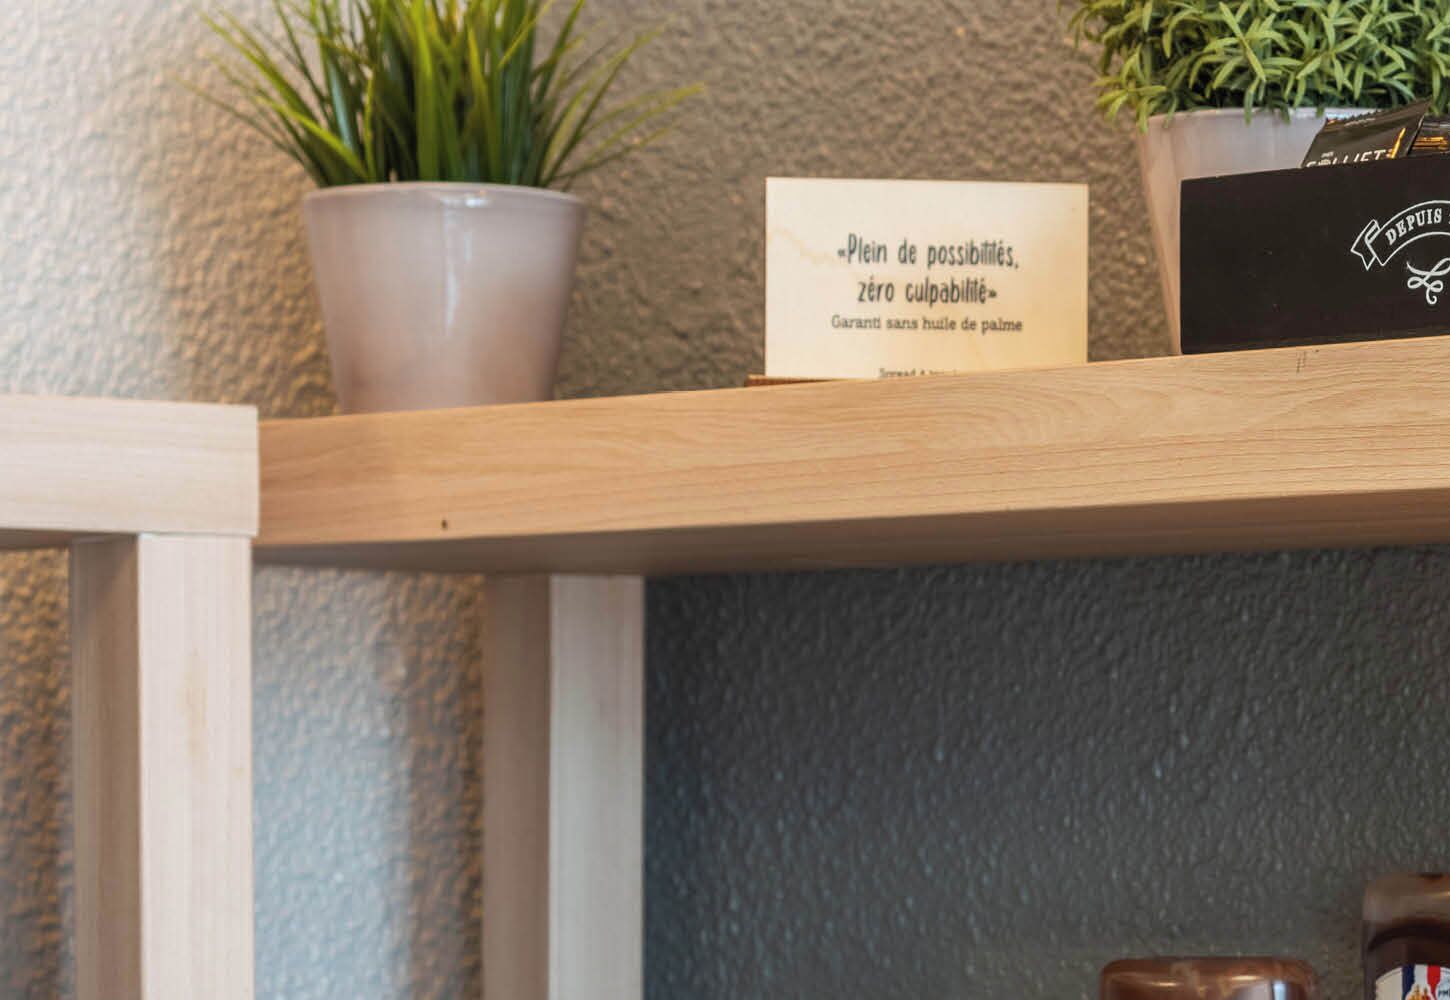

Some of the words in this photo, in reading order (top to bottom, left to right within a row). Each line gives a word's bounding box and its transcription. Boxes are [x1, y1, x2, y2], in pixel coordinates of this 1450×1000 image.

[1384, 207, 1443, 246] DEPUIS
[837, 232, 888, 264] «Plein
[897, 236, 918, 265] de
[927, 238, 1020, 270] possibilités,
[857, 274, 896, 303] zéro
[831, 314, 882, 330] Garanti
[886, 318, 919, 330] sans
[922, 316, 957, 331] huile
[960, 317, 978, 331] de
[981, 317, 1023, 336] palme
